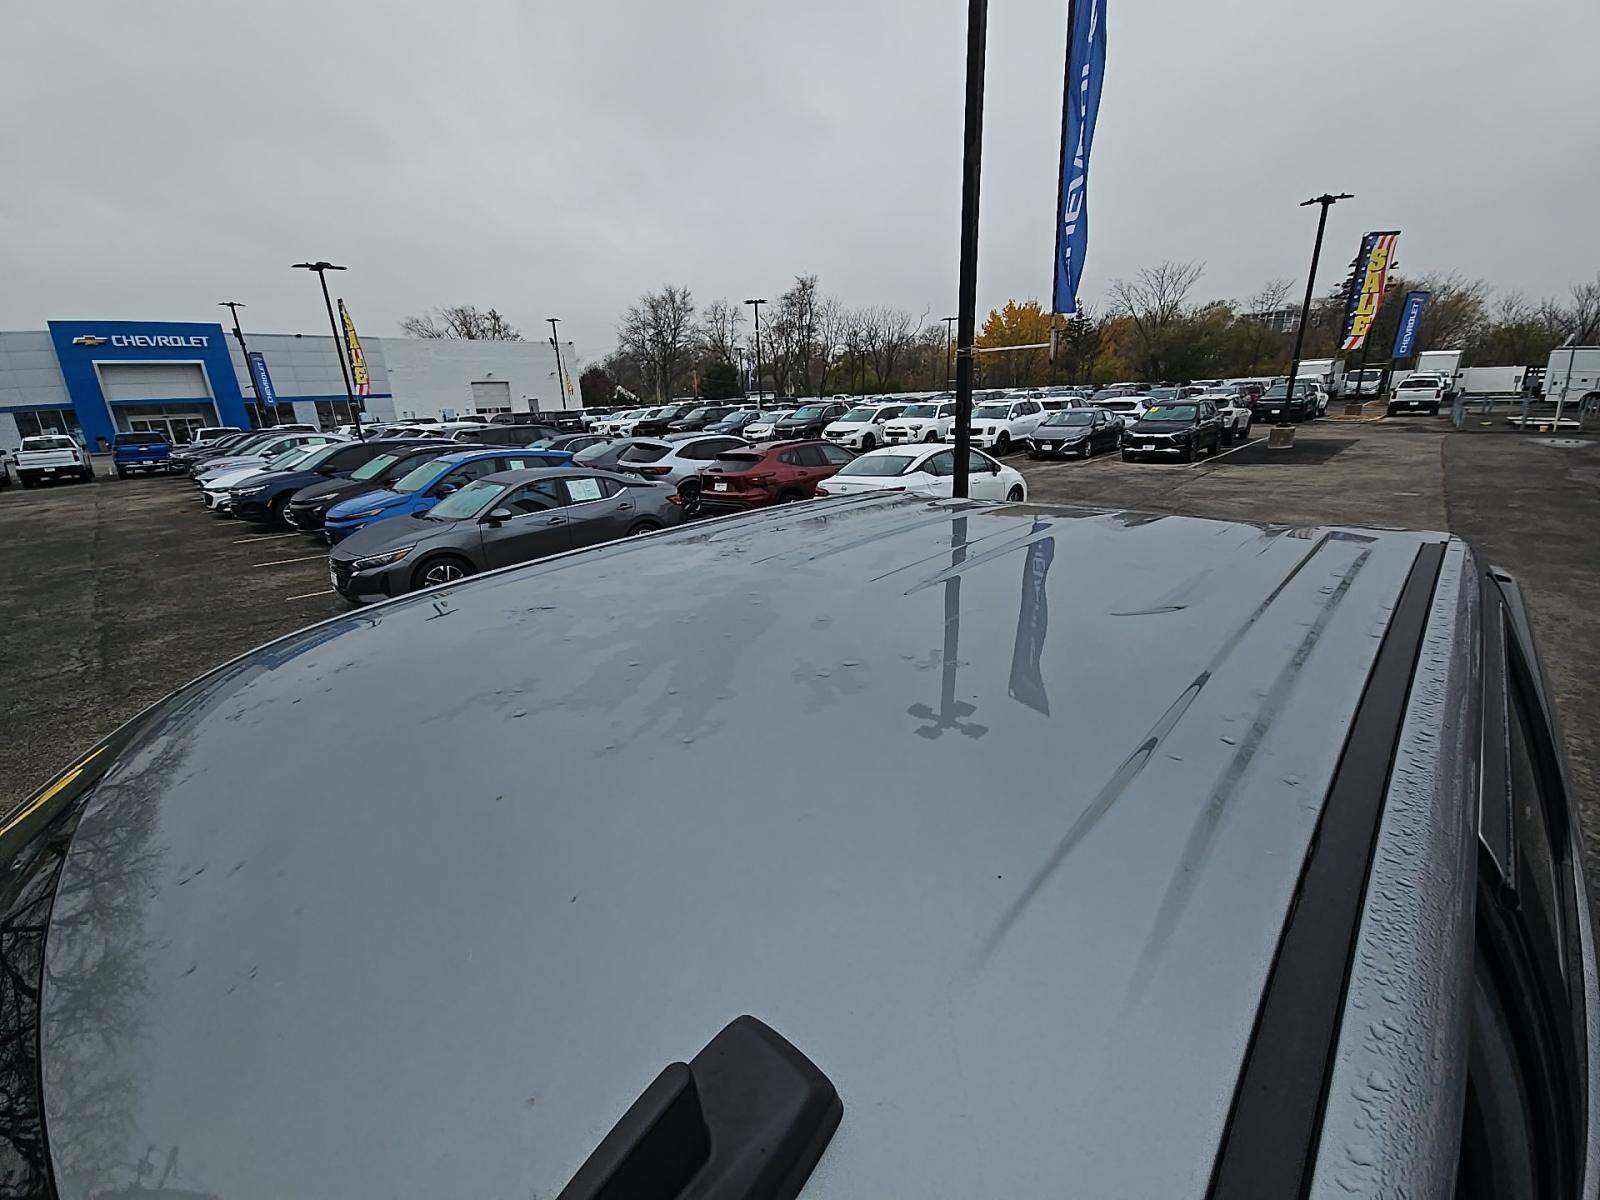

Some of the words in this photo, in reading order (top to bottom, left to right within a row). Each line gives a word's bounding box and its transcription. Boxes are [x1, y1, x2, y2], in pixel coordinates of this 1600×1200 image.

[1351, 249, 1389, 335] SALE
[111, 335, 209, 347] CHEVROLET
[343, 312, 368, 385] SALE
[1400, 303, 1420, 353] CHEVROLET
[257, 362, 274, 403] CHEVROLET
